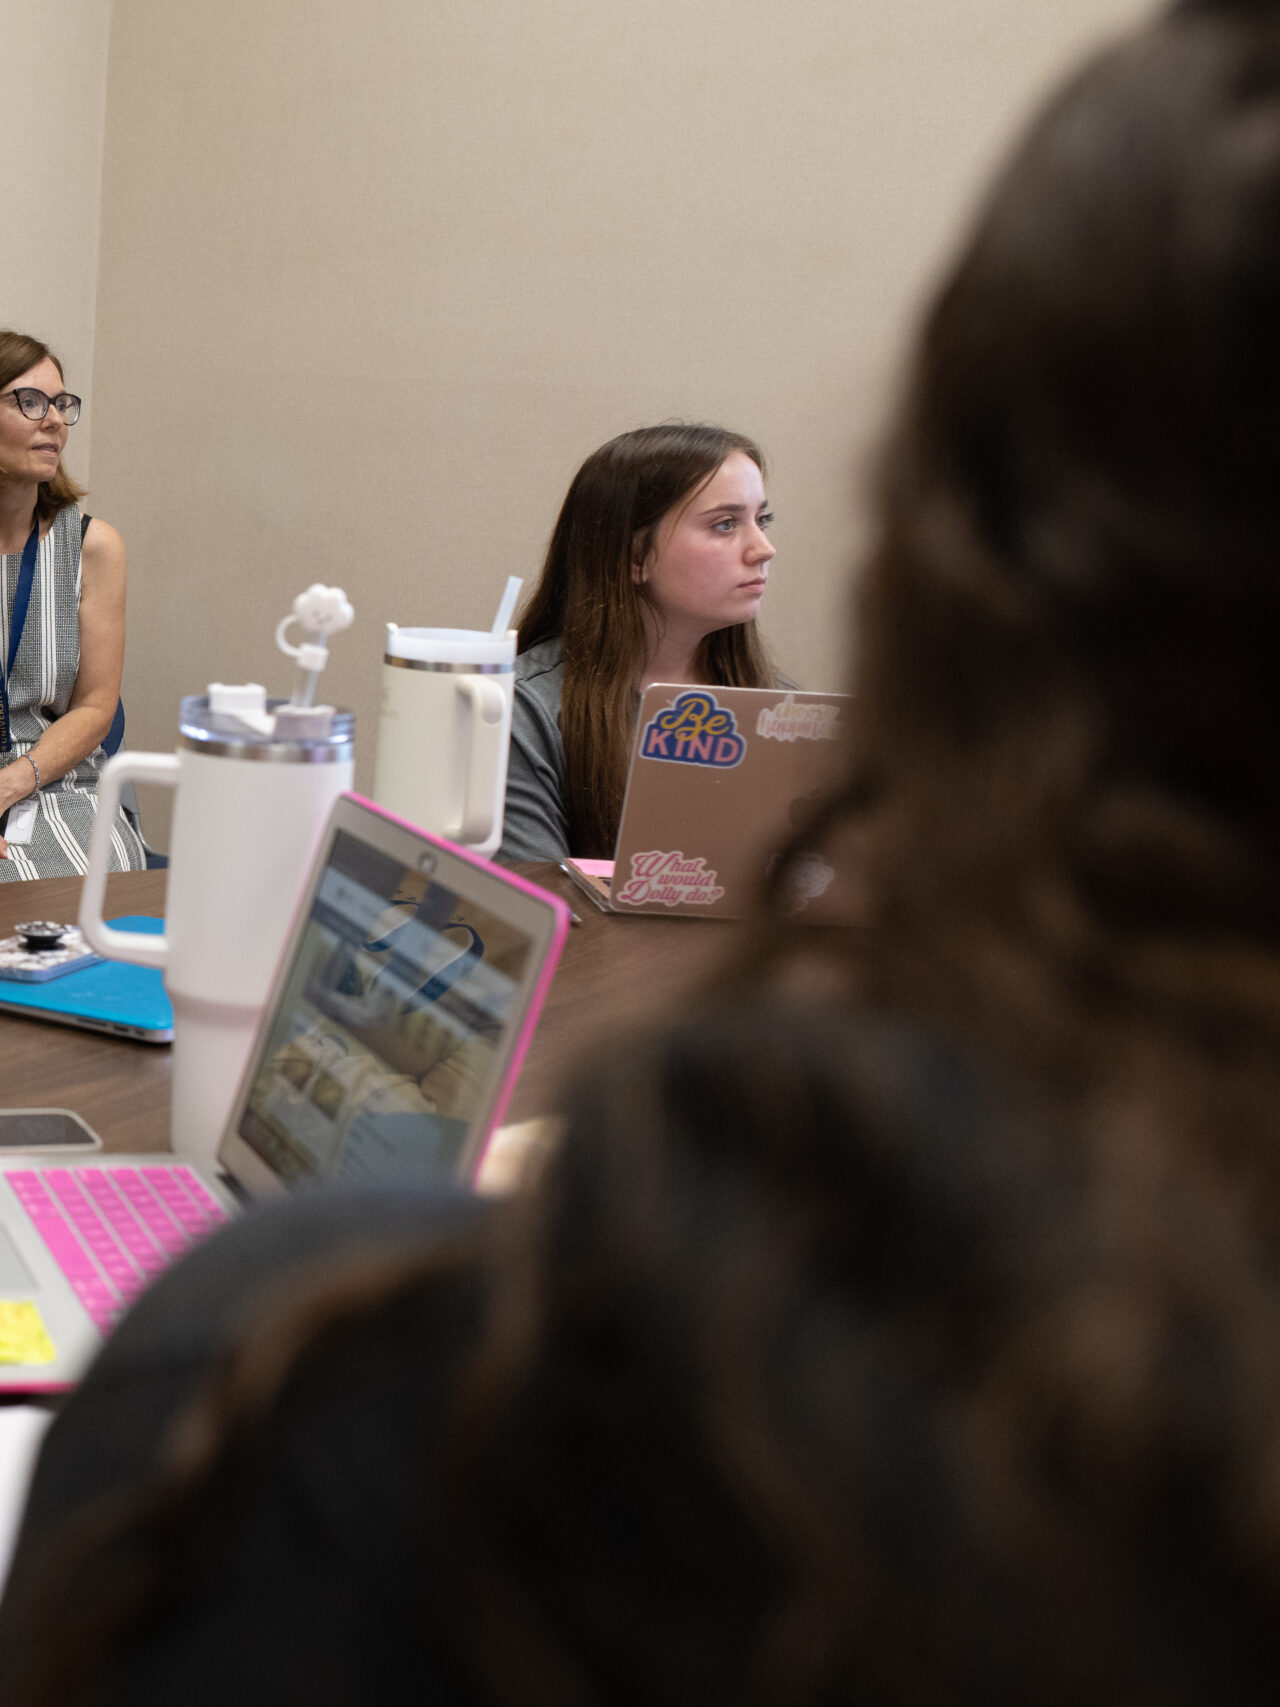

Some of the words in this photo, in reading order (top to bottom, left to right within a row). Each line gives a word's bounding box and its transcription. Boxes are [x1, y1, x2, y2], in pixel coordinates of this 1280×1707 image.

[661, 698, 730, 741] Be
[647, 729, 739, 762] KIND
[634, 852, 704, 877] What
[620, 879, 684, 904] Dolly
[685, 887, 722, 903] do?
[657, 872, 714, 887] would
